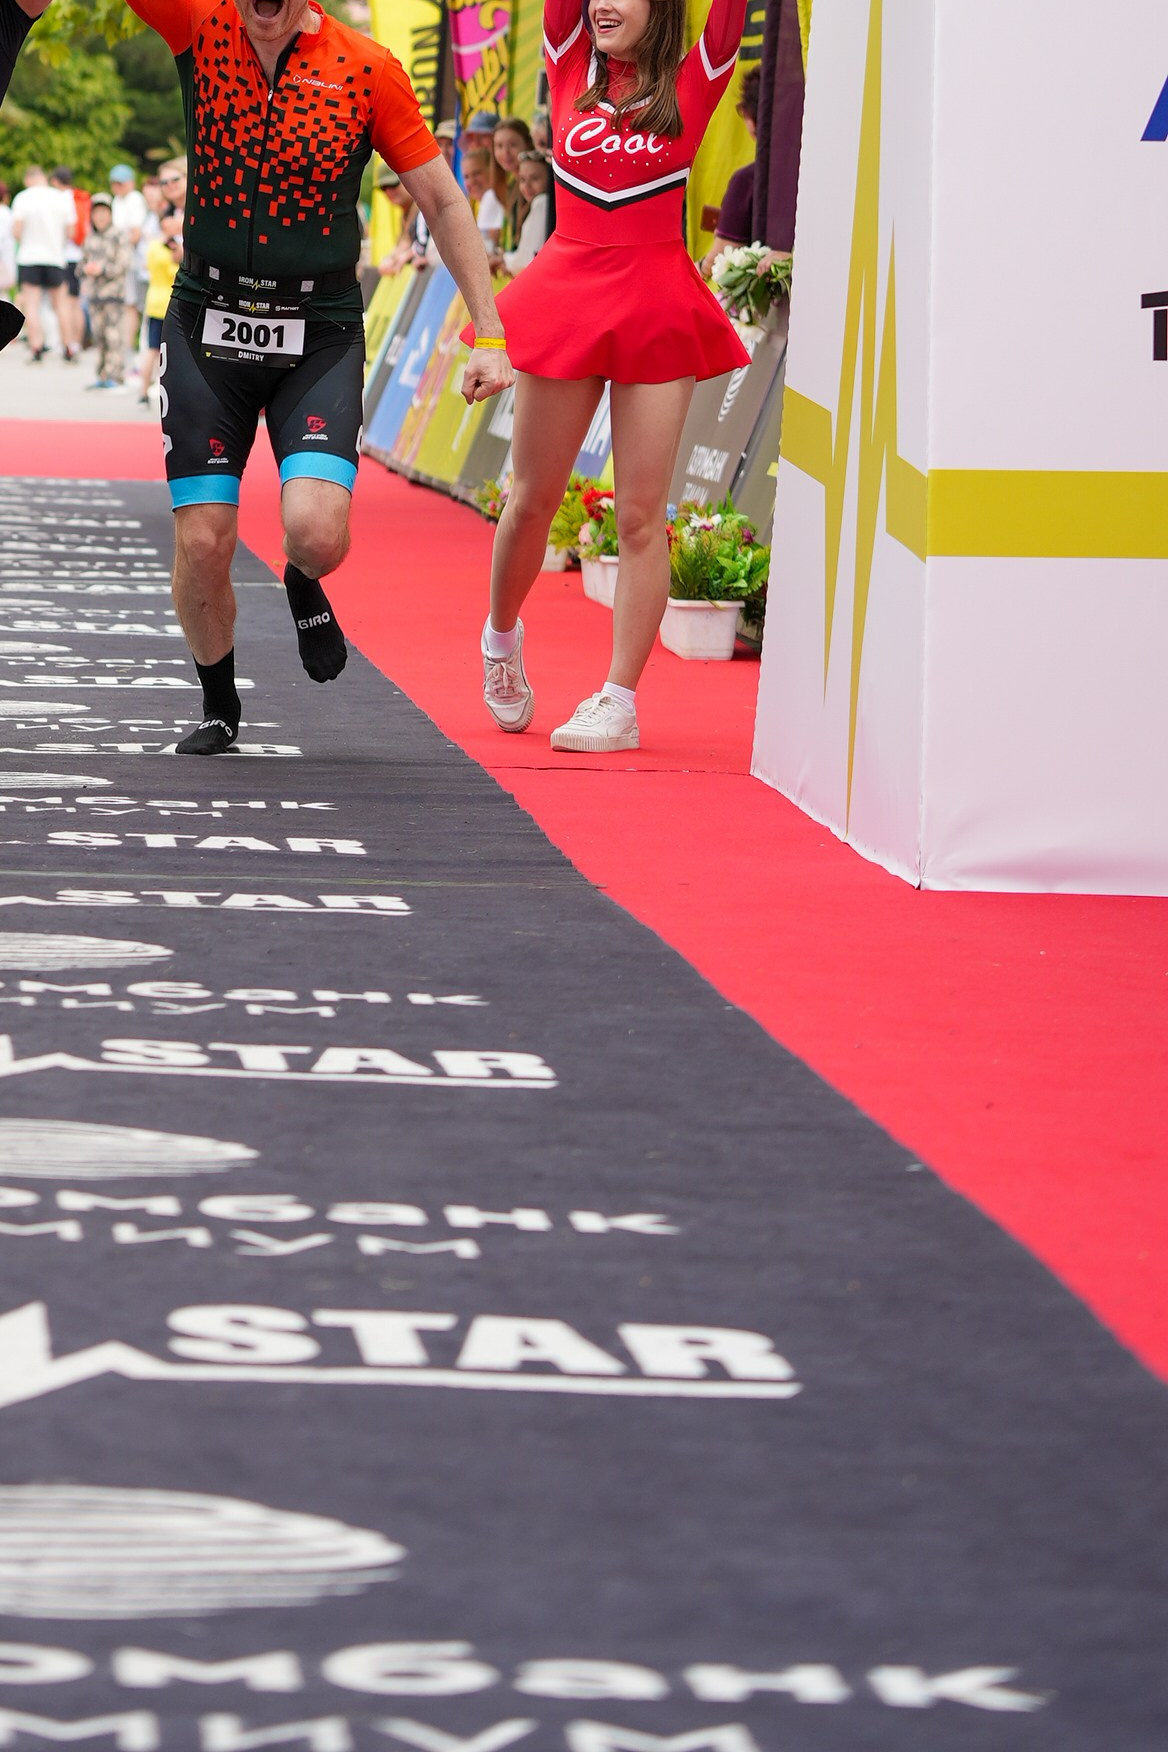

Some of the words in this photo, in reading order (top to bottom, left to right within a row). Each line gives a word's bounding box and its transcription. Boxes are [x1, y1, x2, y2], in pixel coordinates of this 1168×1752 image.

[238, 275, 254, 285] IRON
[260, 279, 277, 288] STAR
[221, 318, 285, 348] 2001
[237, 351, 265, 362] DMITRY
[297, 611, 331, 631] GIRO
[198, 719, 233, 737] GIRO
[46, 831, 369, 855] STAR
[55, 889, 412, 911] STAR
[100, 1038, 557, 1079] STAR
[166, 1303, 796, 1381] STAR
